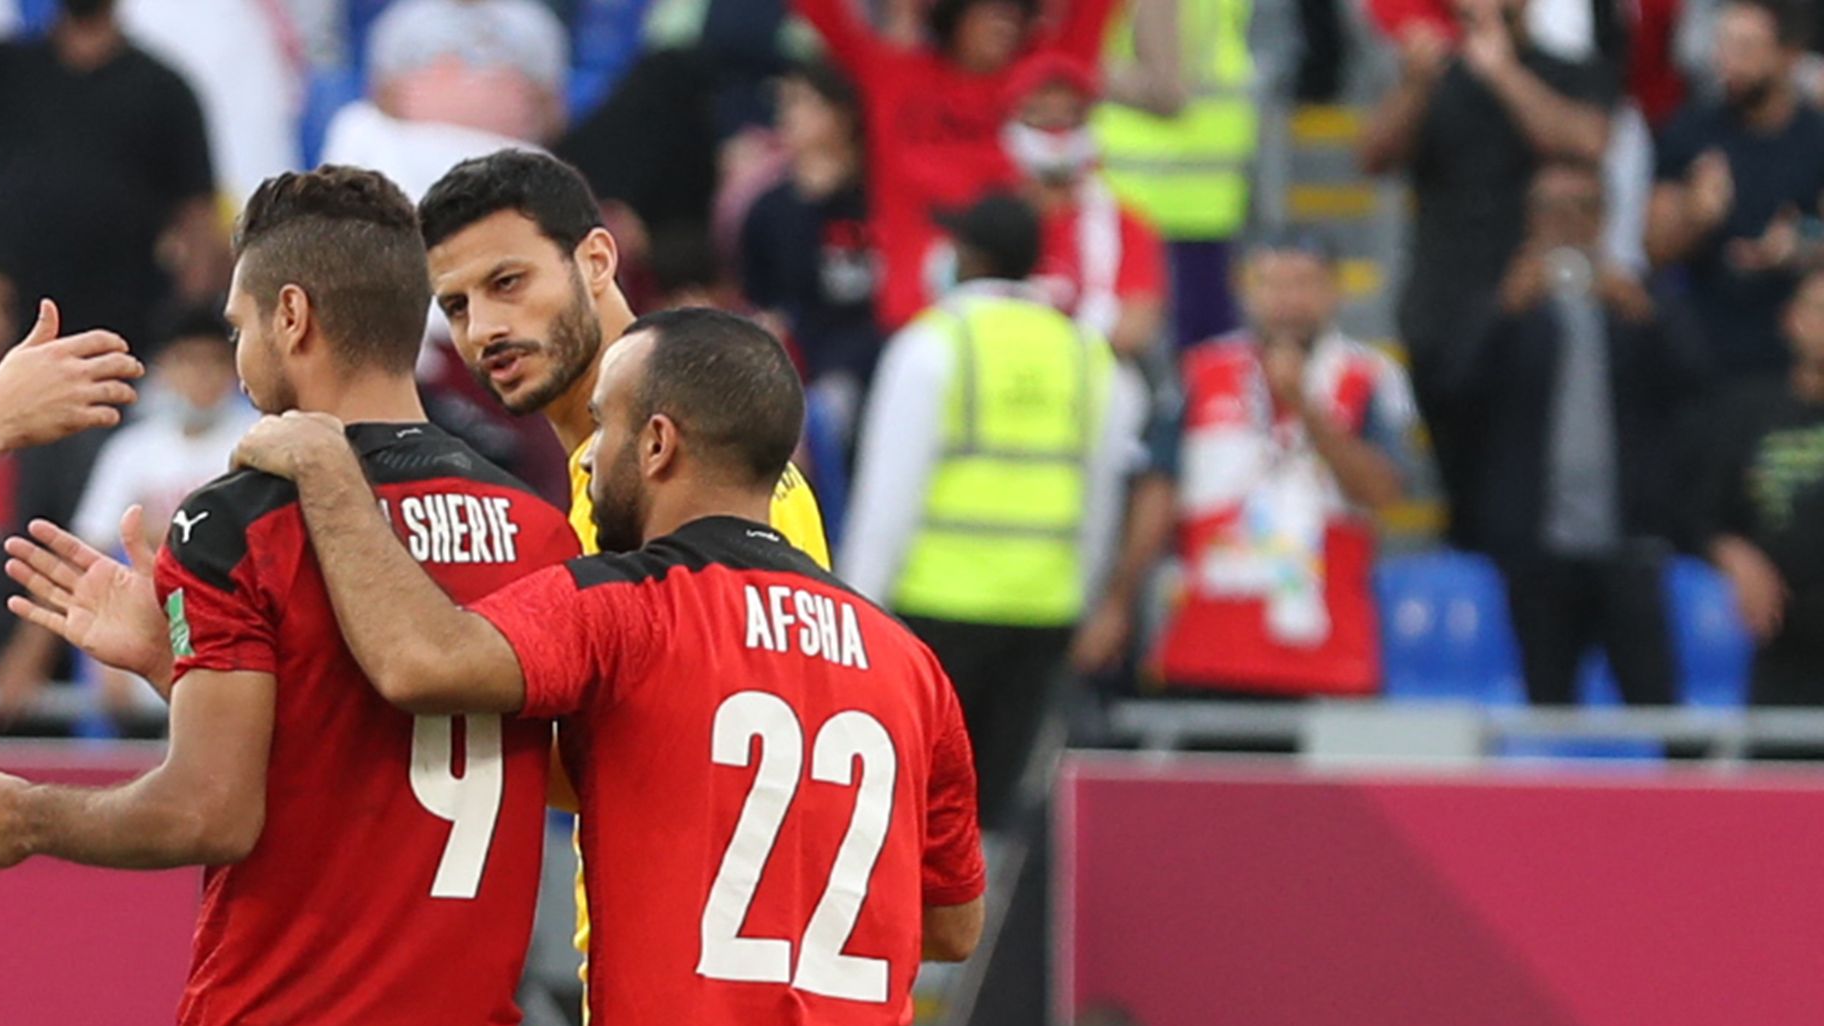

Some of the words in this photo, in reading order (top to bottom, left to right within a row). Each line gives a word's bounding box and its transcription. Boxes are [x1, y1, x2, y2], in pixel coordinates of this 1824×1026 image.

[401, 493, 519, 563] SHERIF
[744, 584, 870, 670] AFSHA
[409, 714, 504, 899] 9
[695, 691, 898, 1003] 22
